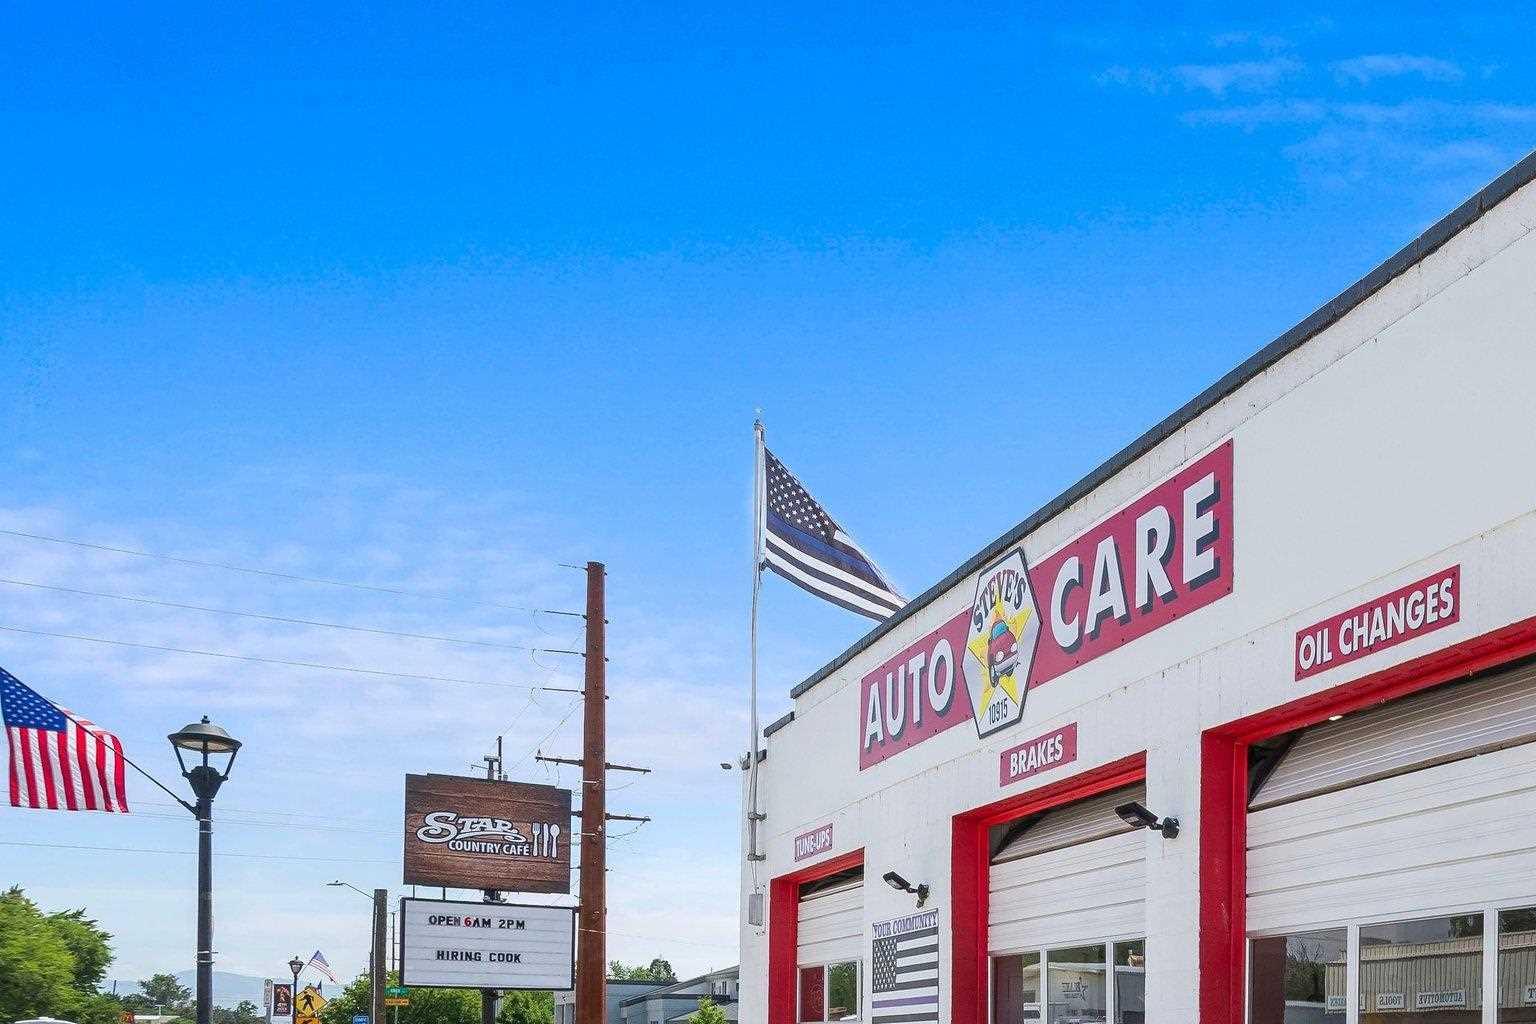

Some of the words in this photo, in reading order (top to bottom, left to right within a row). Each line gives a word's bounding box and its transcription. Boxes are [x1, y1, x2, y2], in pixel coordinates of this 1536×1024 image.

[864, 638, 956, 751] AUTO
[1049, 471, 1220, 655] CARE
[973, 568, 1027, 633] STEVE'S
[1299, 628, 1333, 671] OIL
[1338, 577, 1455, 657] CHANGES
[988, 697, 1008, 727] 10915
[1010, 733, 1064, 778] BRAKES
[416, 811, 527, 844] STAR
[449, 839, 500, 854] COUNTRY
[797, 828, 831, 858] TUNE-UPS
[428, 914, 461, 927] OPEN
[464, 916, 492, 929] 6AM
[498, 919, 526, 931] 2PM
[872, 921, 892, 938] YOUR
[893, 910, 937, 935] COMMUNITY
[436, 950, 482, 963] HIRING
[489, 952, 522, 964] COOK
